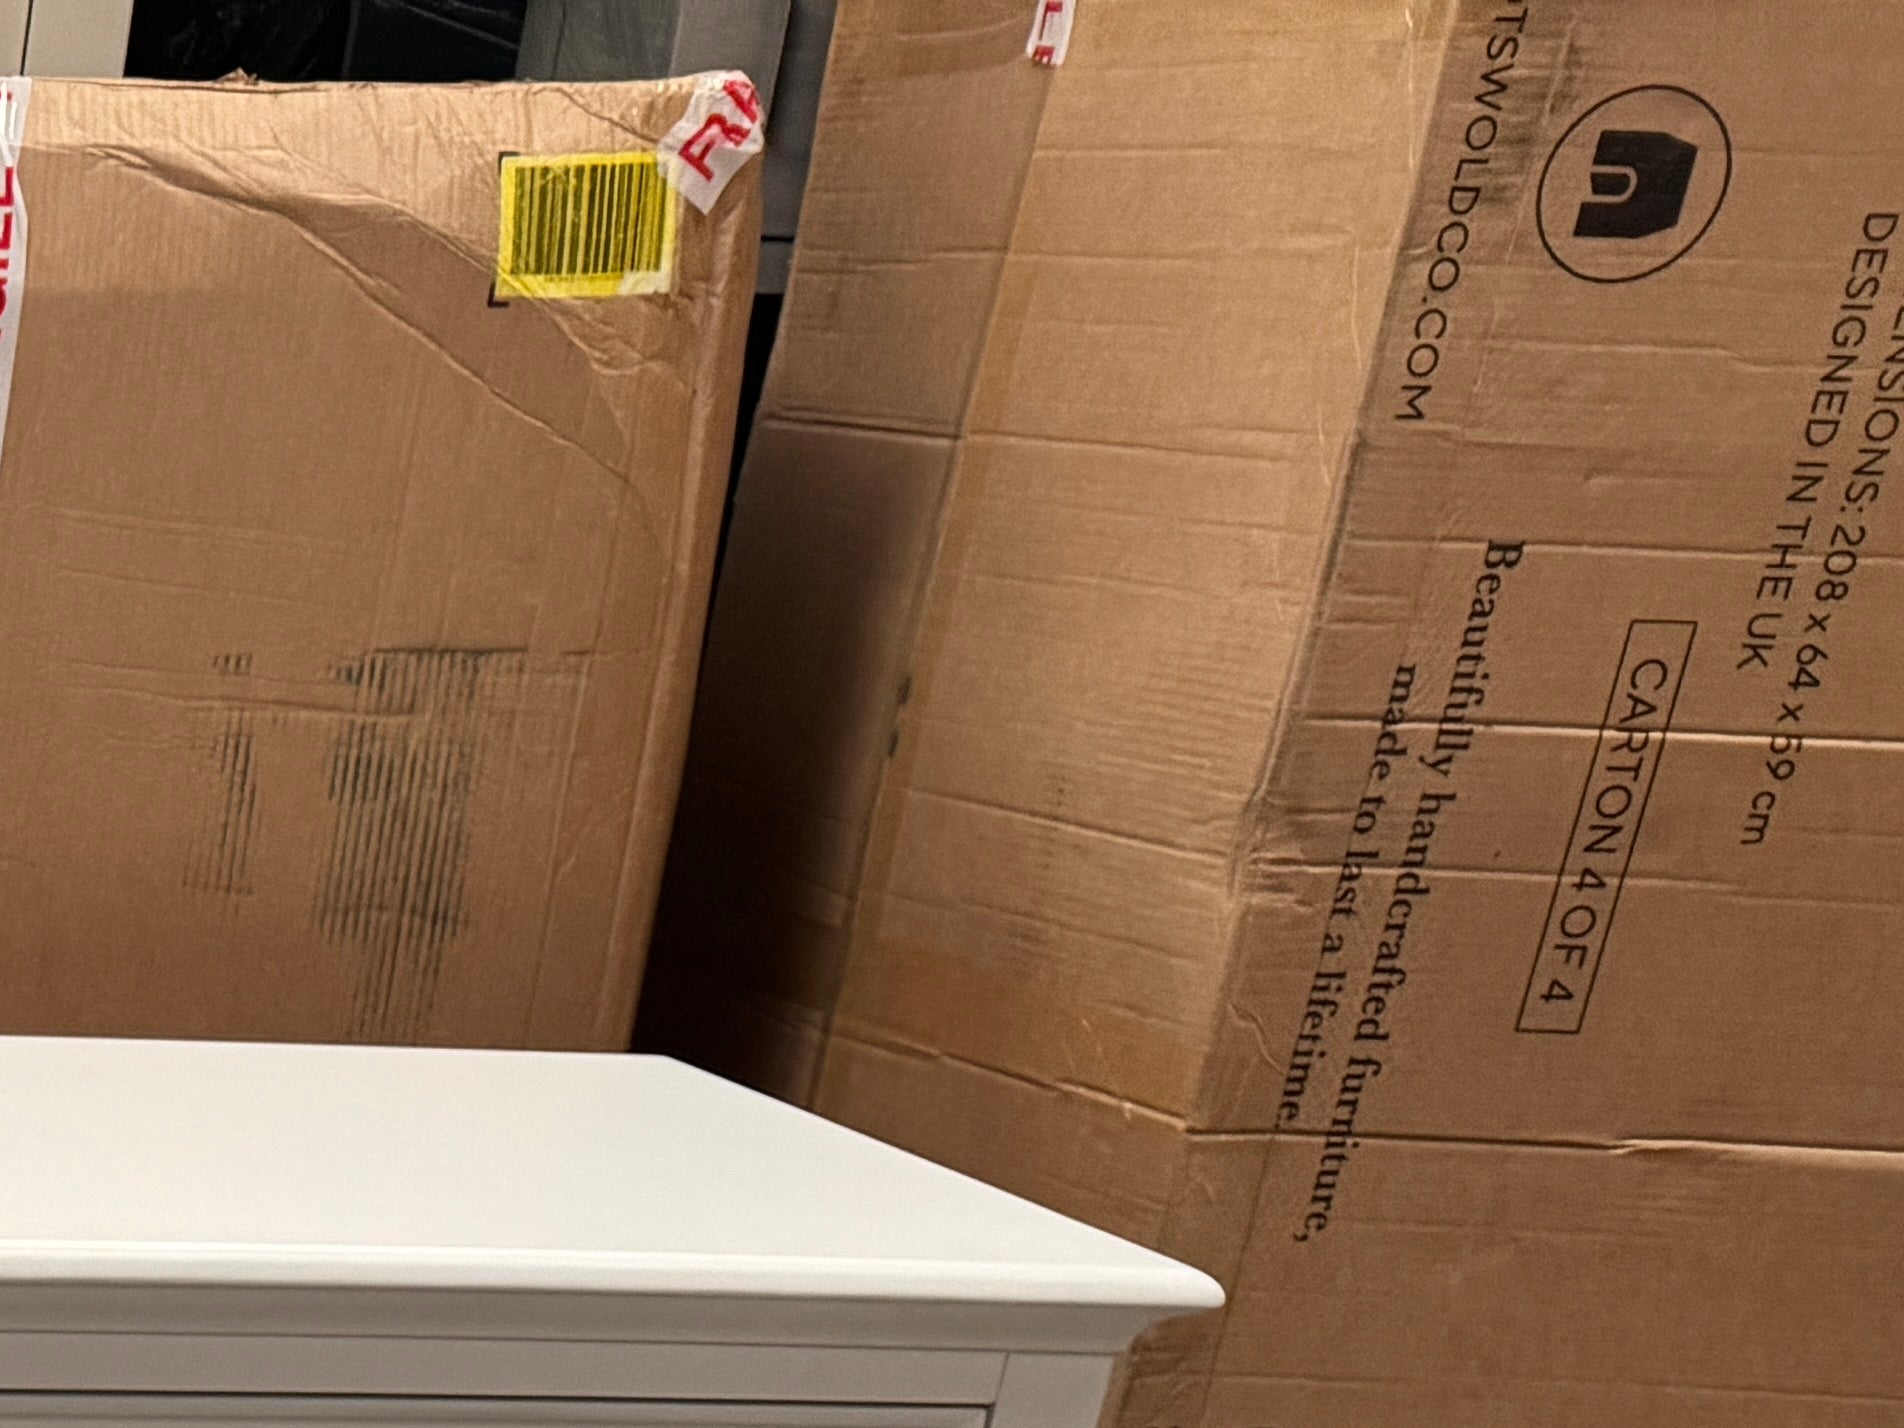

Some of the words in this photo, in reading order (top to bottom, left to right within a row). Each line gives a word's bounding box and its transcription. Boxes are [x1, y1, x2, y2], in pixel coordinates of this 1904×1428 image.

[1395, 0, 1529, 421] TSWOLDCO.COM
[1805, 212, 1900, 448] DESIGNED
[1785, 461, 1829, 503] IN
[1756, 515, 1812, 601] THE
[1815, 524, 1866, 601] 208
[1418, 539, 1526, 777] Beautifully
[1736, 613, 1783, 670] UK
[1787, 644, 1829, 691] 64
[1370, 664, 1417, 781] made
[1583, 658, 1669, 854] CARTON
[1352, 794, 1386, 836] to
[1740, 790, 1776, 845] cm
[1330, 851, 1380, 918] last
[1571, 867, 1607, 892] 4
[1320, 932, 1345, 955] a
[1352, 792, 1457, 1043] handcrafted
[1553, 905, 1597, 969] OF
[1539, 978, 1575, 1003] 4
[1274, 970, 1347, 1130] lifetime.
[1293, 1055, 1383, 1243] furniture,
